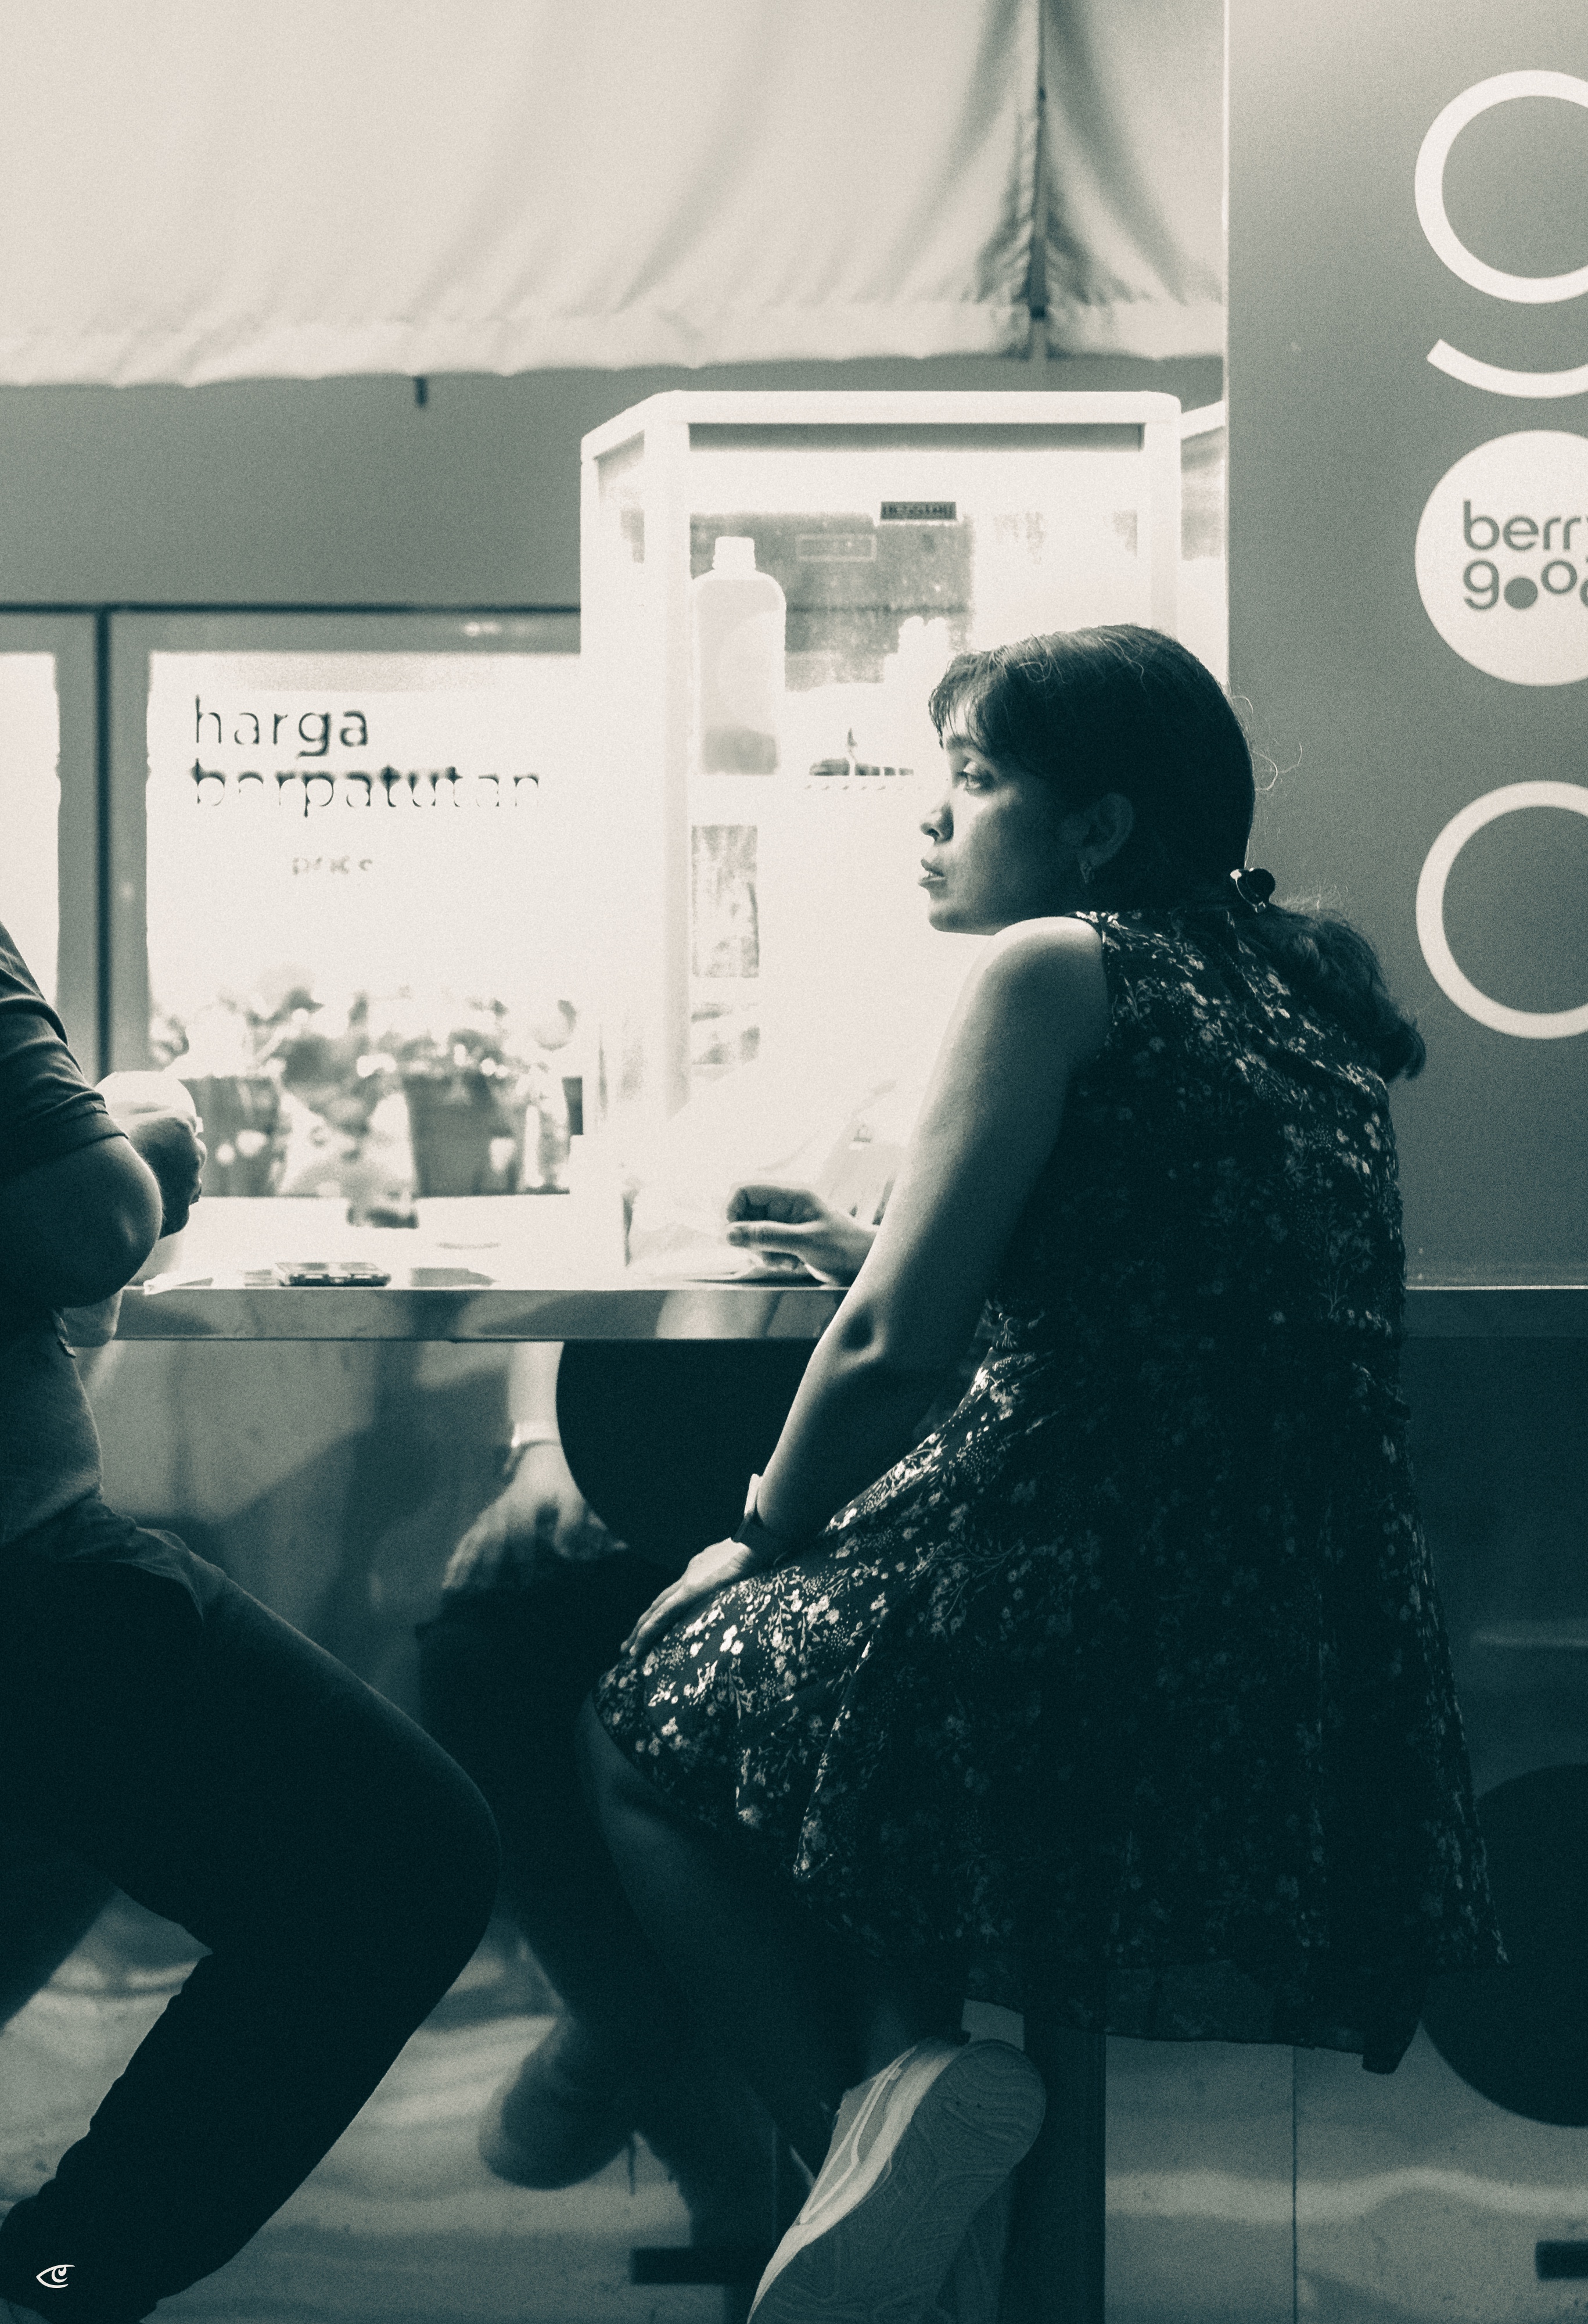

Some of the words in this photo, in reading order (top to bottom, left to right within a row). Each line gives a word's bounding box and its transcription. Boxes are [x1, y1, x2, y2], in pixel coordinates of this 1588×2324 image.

[1463, 499, 1588, 551] berr
[1463, 558, 1588, 612] goo
[195, 694, 370, 758] harga
